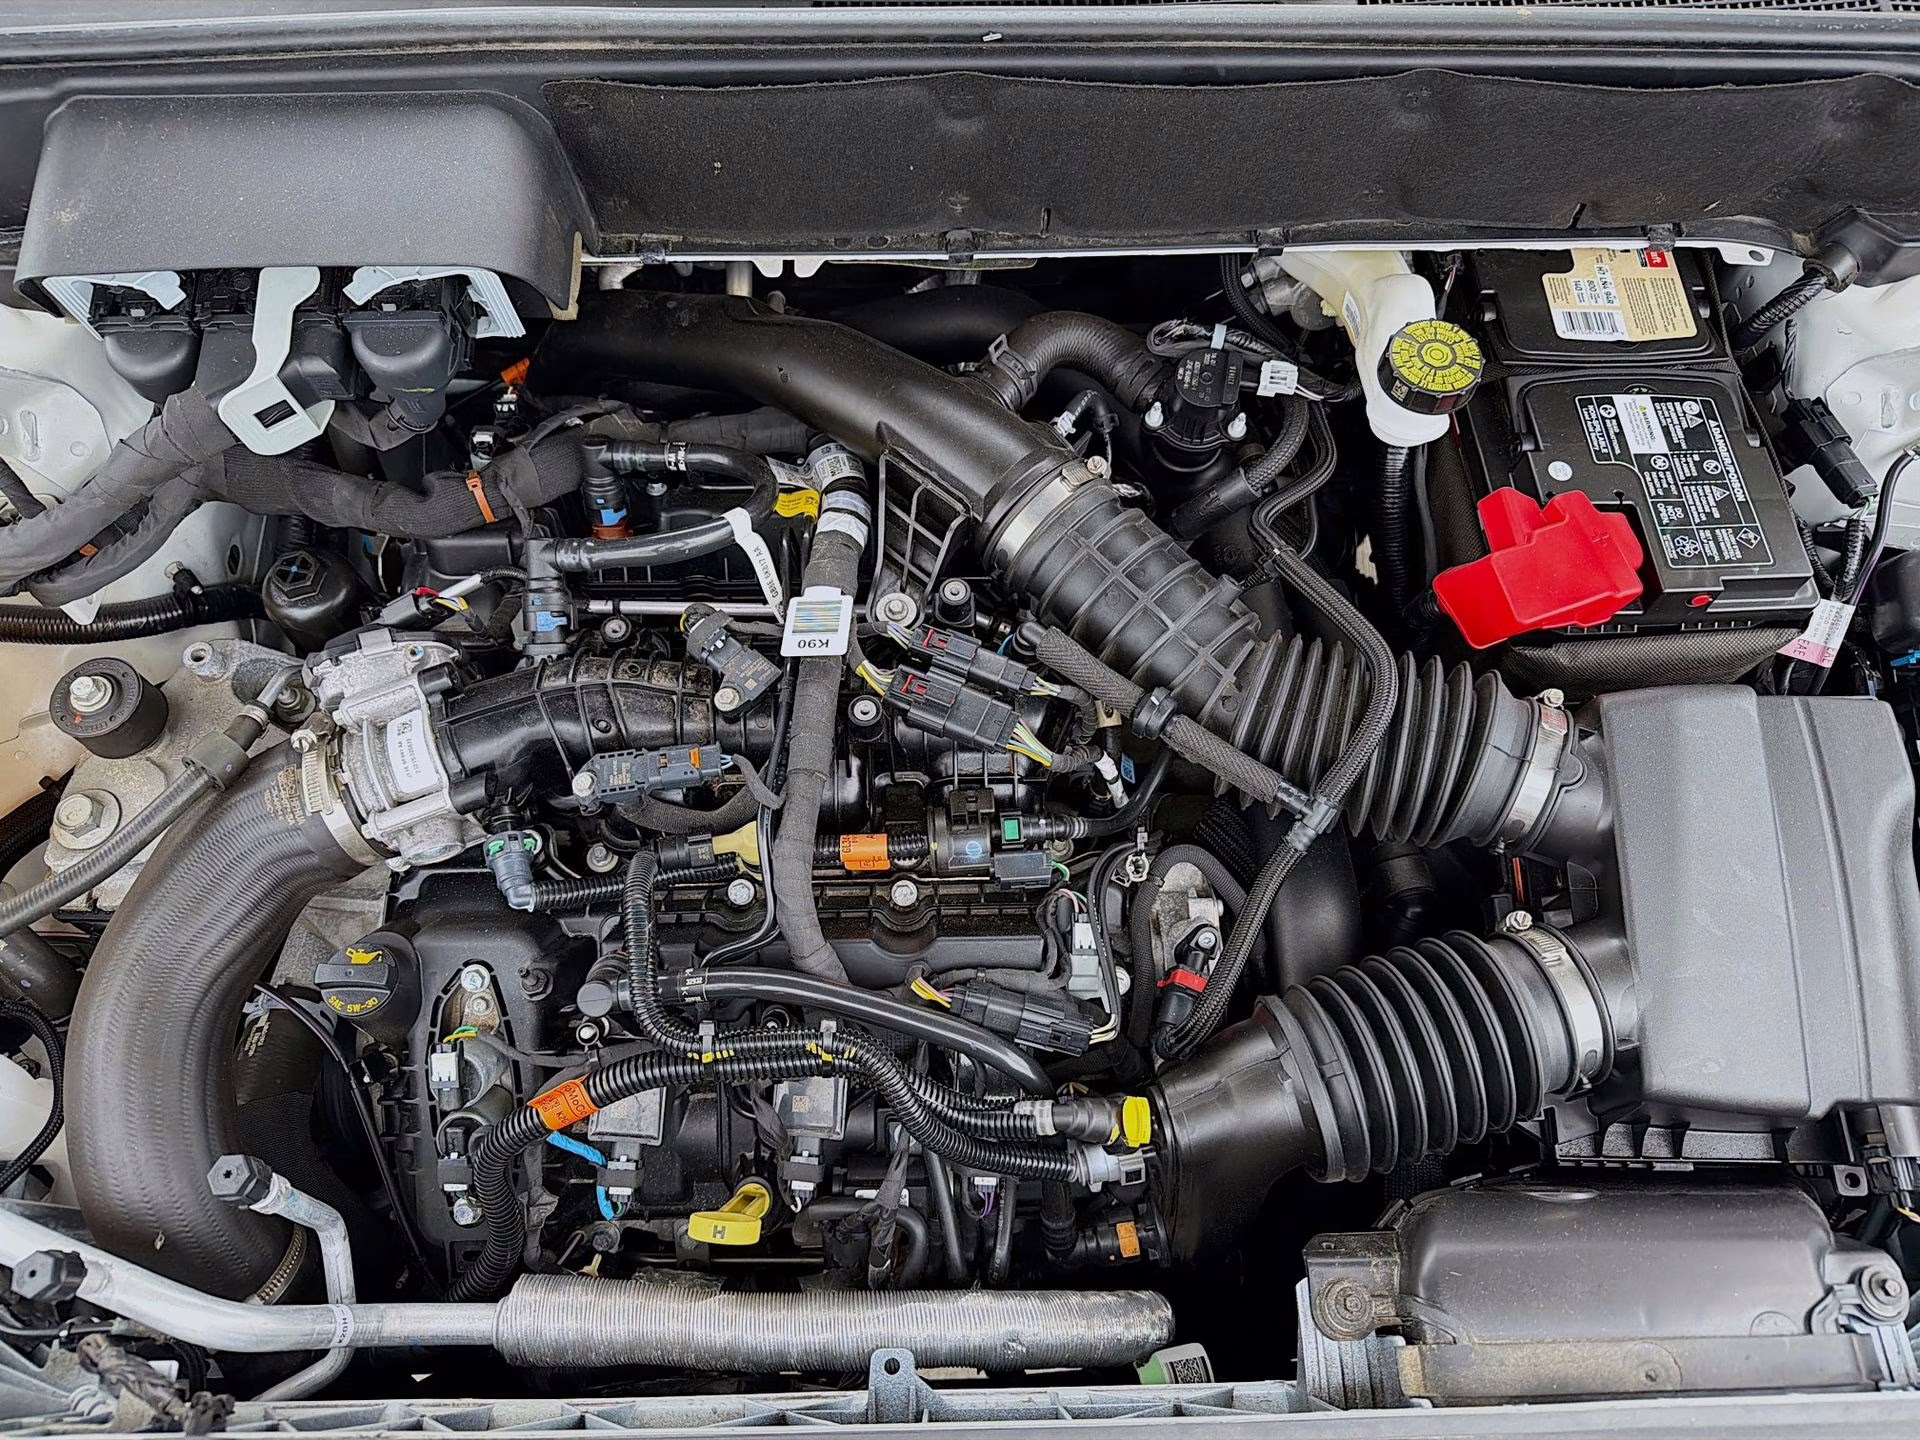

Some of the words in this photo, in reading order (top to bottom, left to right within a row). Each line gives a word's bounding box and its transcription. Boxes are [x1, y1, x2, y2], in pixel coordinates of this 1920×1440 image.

[1665, 505, 1677, 520] NOT
[1673, 507, 1684, 518] DO
[797, 639, 830, 649] K90
[328, 996, 344, 1011] SAE
[347, 997, 378, 1013] 5W-30
[713, 1225, 726, 1239] H
